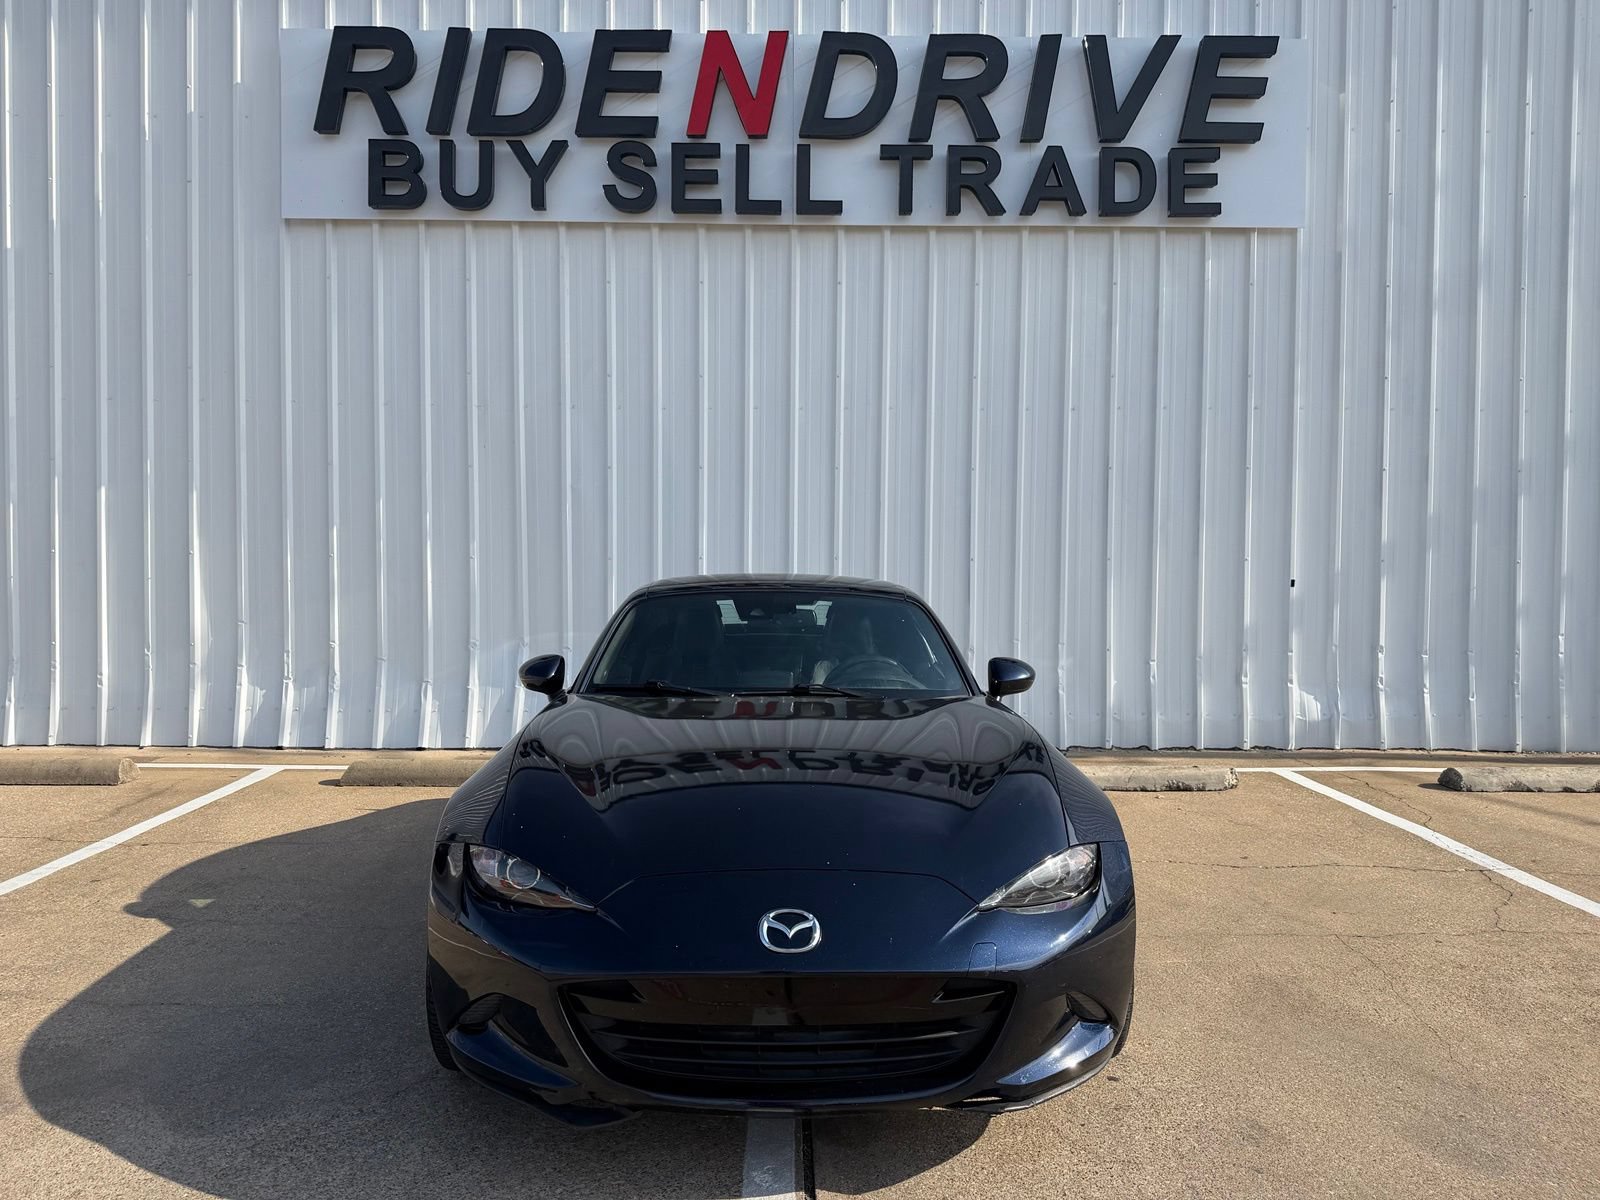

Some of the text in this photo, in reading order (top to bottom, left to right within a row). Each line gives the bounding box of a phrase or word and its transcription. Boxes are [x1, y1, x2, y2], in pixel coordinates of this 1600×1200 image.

[368, 139, 1222, 218] BUY SELL TRADE
